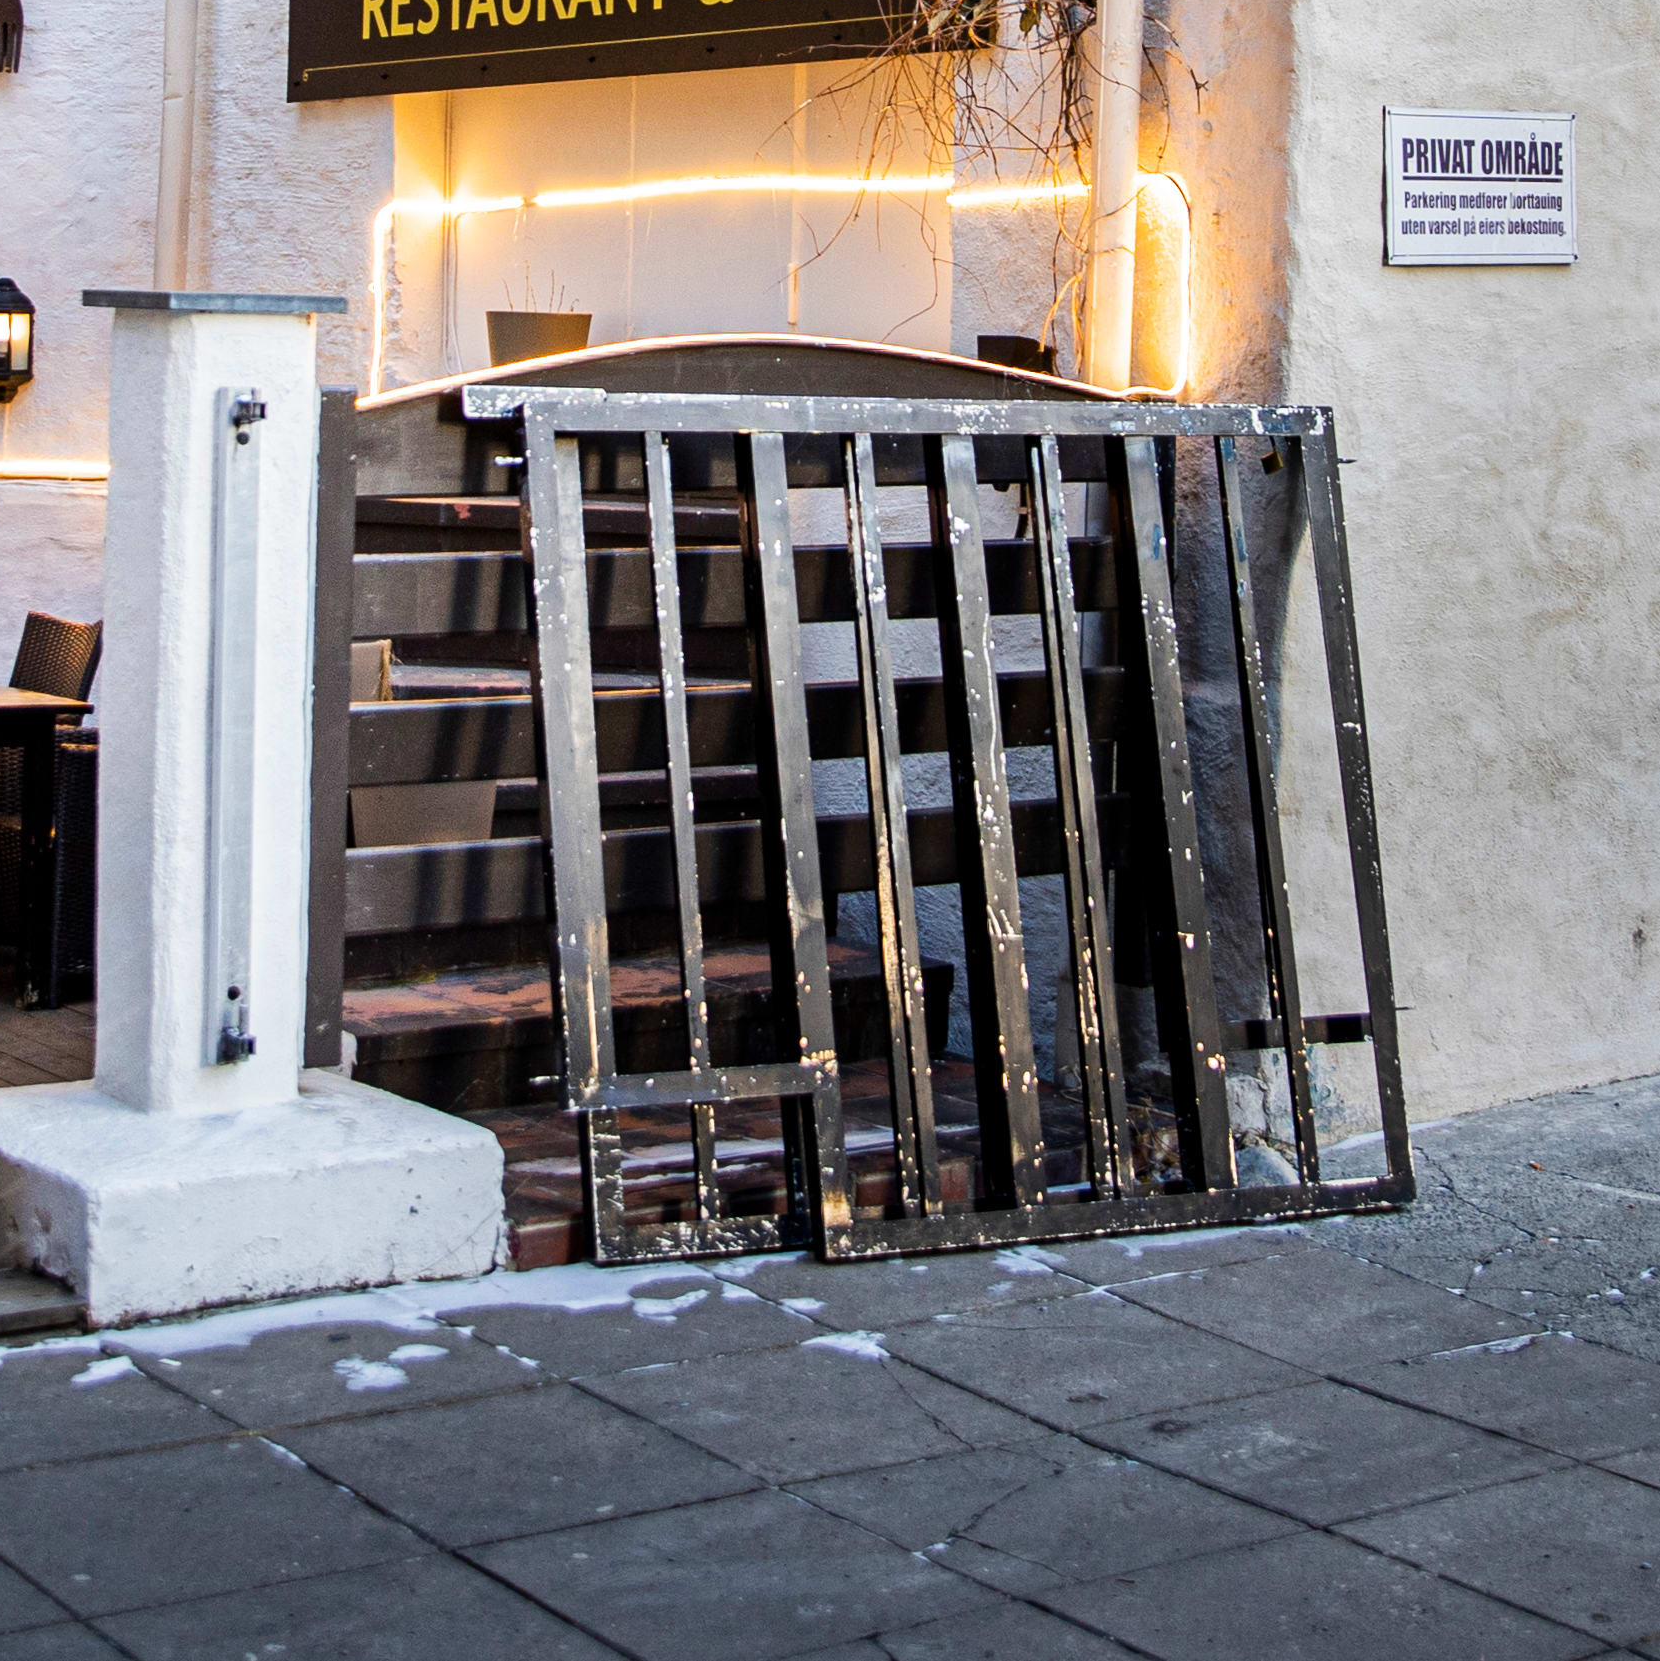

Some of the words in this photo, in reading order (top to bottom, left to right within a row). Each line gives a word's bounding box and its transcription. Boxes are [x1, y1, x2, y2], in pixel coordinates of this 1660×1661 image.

[1402, 138, 1475, 174] PRIVAT
[1481, 132, 1563, 176] OMRÅDE
[1404, 191, 1456, 210] Parkering
[1401, 219, 1426, 235] uten
[1428, 218, 1461, 235] varsel
[1463, 215, 1476, 237] på
[1478, 218, 1505, 235] eiers
